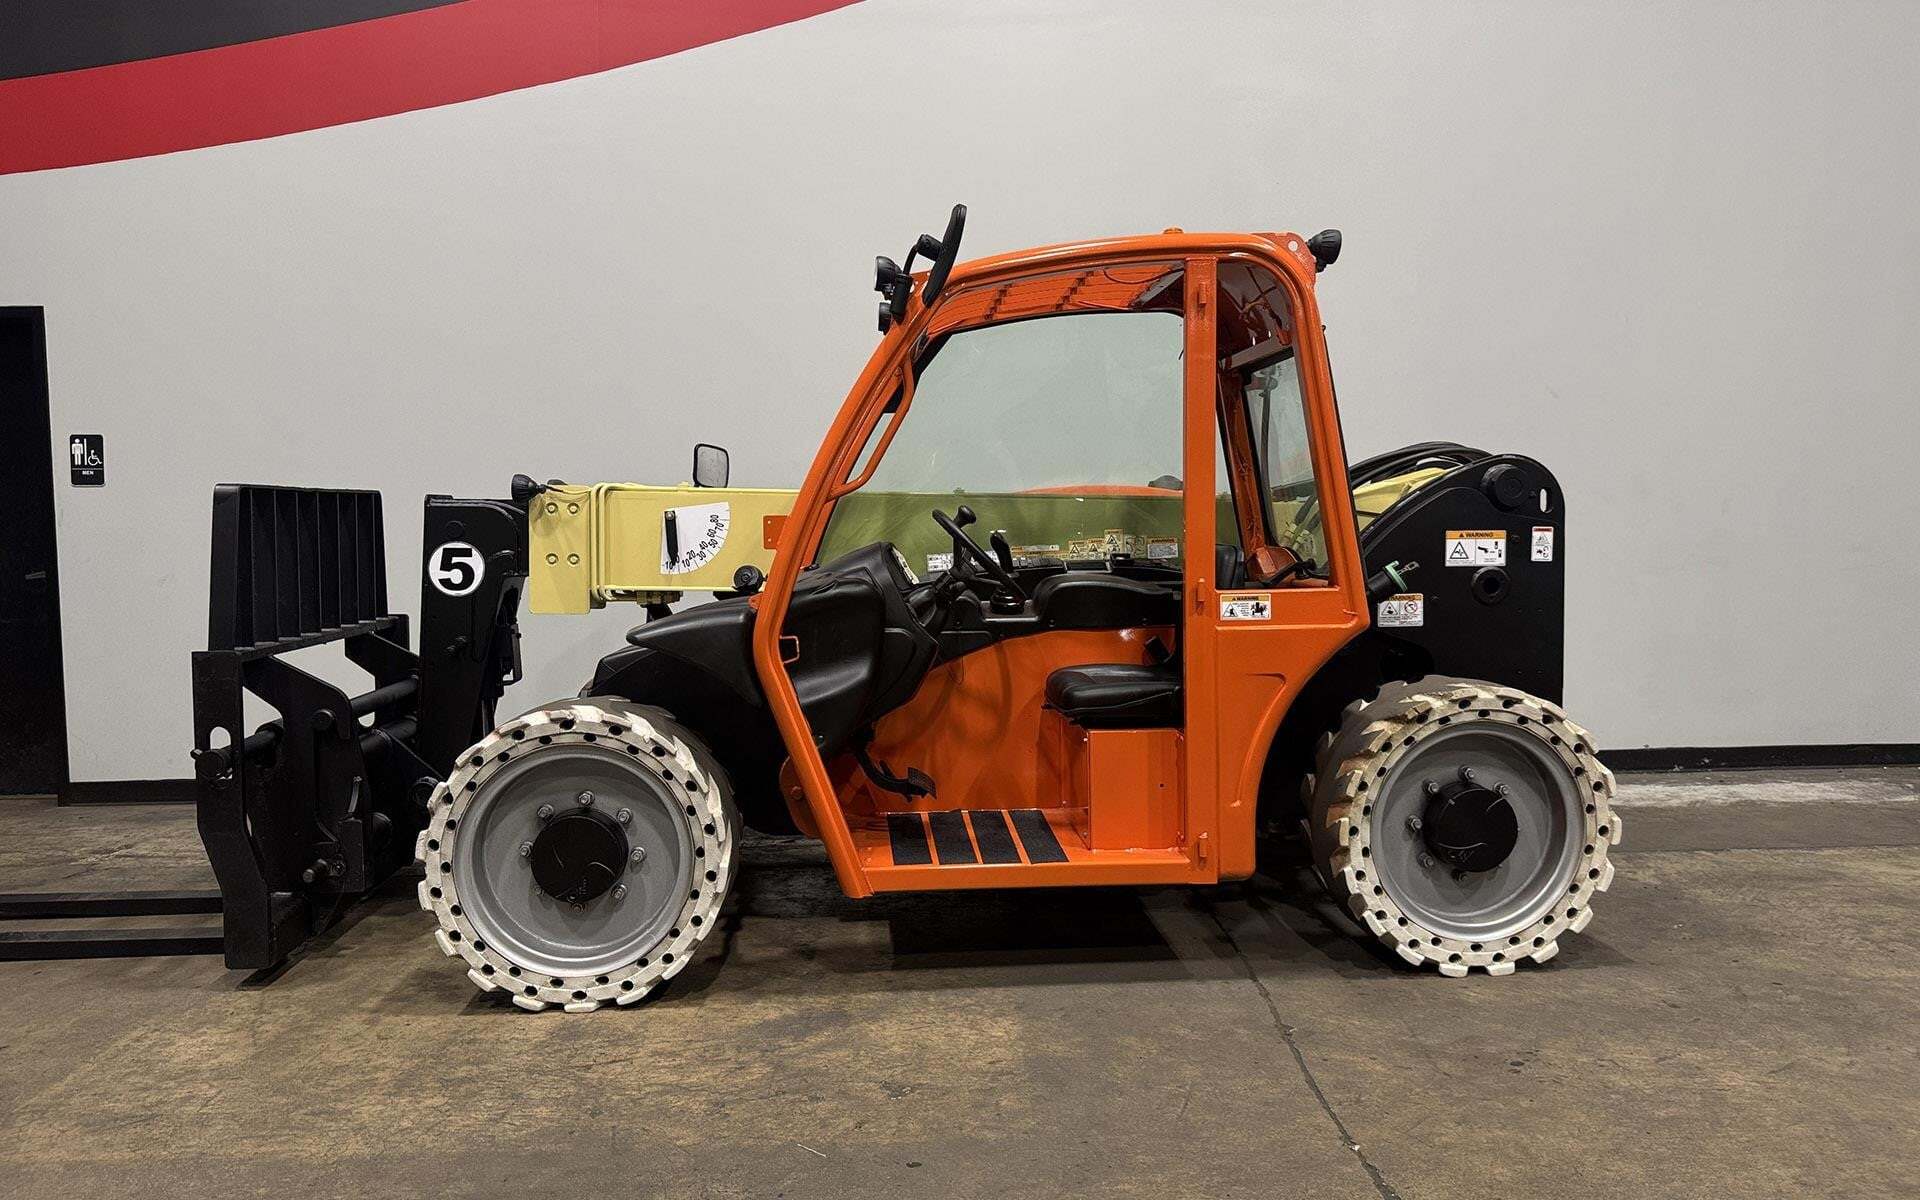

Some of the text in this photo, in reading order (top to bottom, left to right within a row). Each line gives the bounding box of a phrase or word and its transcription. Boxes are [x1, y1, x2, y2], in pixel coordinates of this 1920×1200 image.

[710, 515, 719, 523] 80
[715, 523, 724, 532] 70
[707, 529, 717, 538] 60
[699, 541, 709, 550] 40
[708, 539, 718, 548] 50
[686, 550, 696, 560] 20
[697, 551, 707, 560] 30
[682, 559, 690, 568] 10
[438, 547, 475, 591] 5
